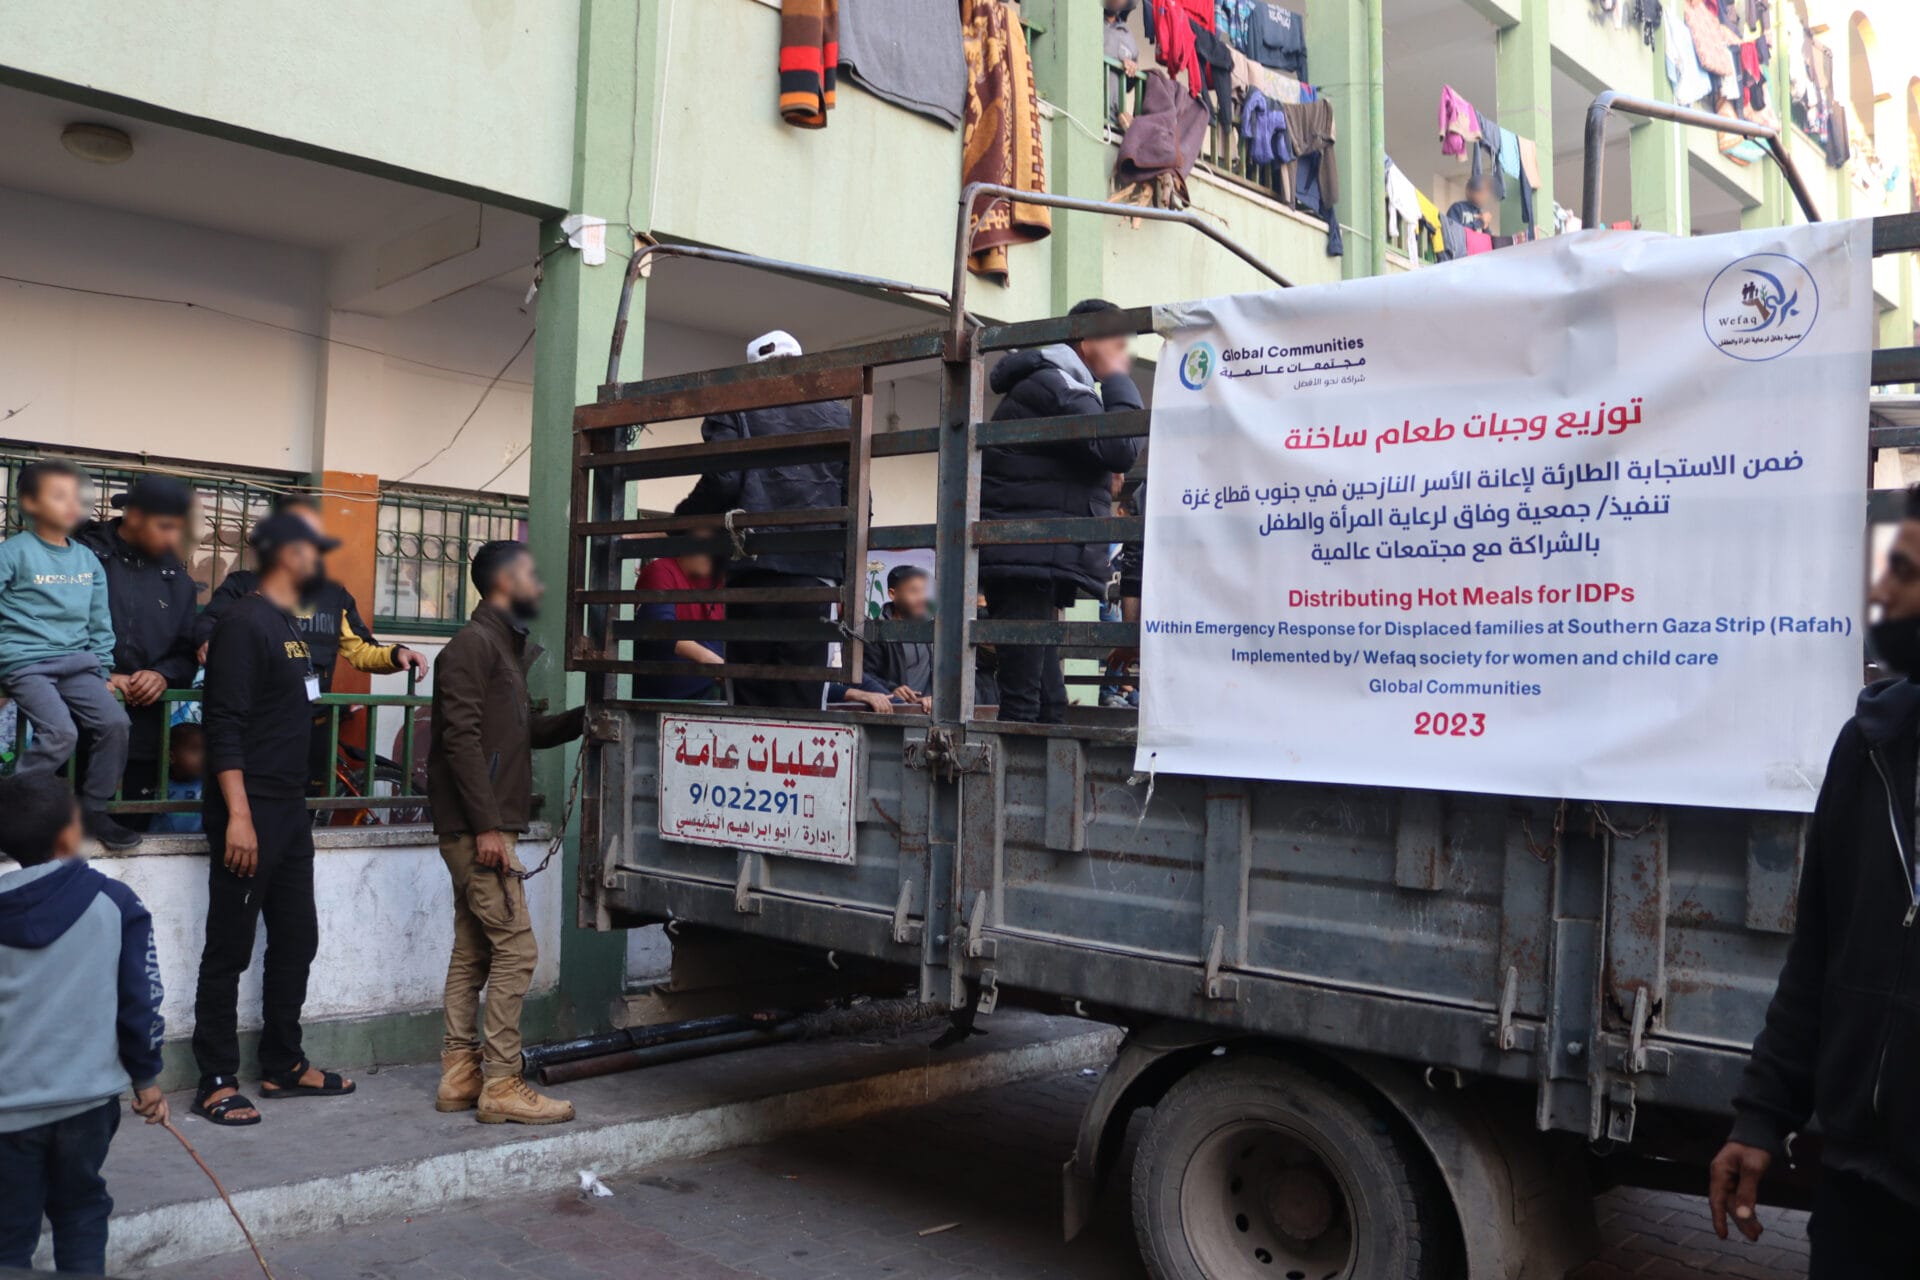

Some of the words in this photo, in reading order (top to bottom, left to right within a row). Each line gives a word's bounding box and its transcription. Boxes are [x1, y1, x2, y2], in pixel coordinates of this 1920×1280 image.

[1718, 315, 1757, 326] Wefaq
[1222, 346, 1264, 362] Global
[1268, 337, 1364, 358] Communities
[1294, 376, 1321, 390] الأفضل
[1324, 376, 1338, 387] نحو
[1341, 374, 1366, 386] شراكة
[1463, 412, 1547, 443] وجبات
[1554, 397, 1643, 438] توزيع
[1284, 425, 1368, 449] ساخنة
[1375, 417, 1455, 453] طعام
[1541, 461, 1619, 490] الطارئة
[1627, 454, 1735, 484] الاستجابة
[1743, 450, 1804, 479] ضمن
[1305, 479, 1337, 501] في
[1342, 474, 1415, 501] النازحين
[1420, 470, 1471, 497] الأسر
[1478, 466, 1535, 493] لإعانة
[1182, 488, 1210, 510] غزة
[1214, 485, 1250, 509] قطاع
[1255, 483, 1300, 506] جنوب
[1259, 511, 1325, 536] والطفل
[1329, 505, 1383, 534] المرأة
[1389, 505, 1447, 531] لرعاية
[1453, 502, 1510, 529] وفاق
[1516, 501, 1590, 525] جمعية
[1311, 541, 1371, 566] عالمية
[1376, 539, 1466, 563] مجتمعات
[1472, 541, 1503, 562] مع
[1509, 530, 1600, 560] بالشراكة
[1288, 588, 1412, 611] Distributing
[1417, 587, 1458, 607] Hot
[1463, 585, 1533, 606] Meals
[1538, 585, 1571, 604] for
[1576, 582, 1635, 602] IDPs
[1145, 620, 1192, 634] Within
[1195, 621, 1275, 638] Emergency
[1278, 621, 1355, 638] Response
[1358, 621, 1381, 635] for
[1384, 620, 1471, 639] Displaced
[1476, 620, 1544, 635] families
[1548, 619, 1564, 635] at
[1568, 618, 1658, 634] Southern
[1662, 617, 1711, 633] Gaza
[1715, 616, 1765, 636] Strip
[1770, 615, 1852, 637] (Rafah)
[1232, 648, 1330, 664] Implemented
[1363, 650, 1416, 667] Wefaq
[1420, 649, 1482, 667] society
[1485, 650, 1510, 665] for
[1513, 653, 1578, 665] women
[1582, 650, 1618, 665] and
[1622, 650, 1671, 665] child
[1675, 653, 1719, 665] care
[1369, 679, 1423, 694] Global
[1426, 679, 1541, 696] Communities
[1414, 711, 1486, 736] 2023
[675, 726, 739, 769] عامة
[747, 734, 839, 788] نقليات
